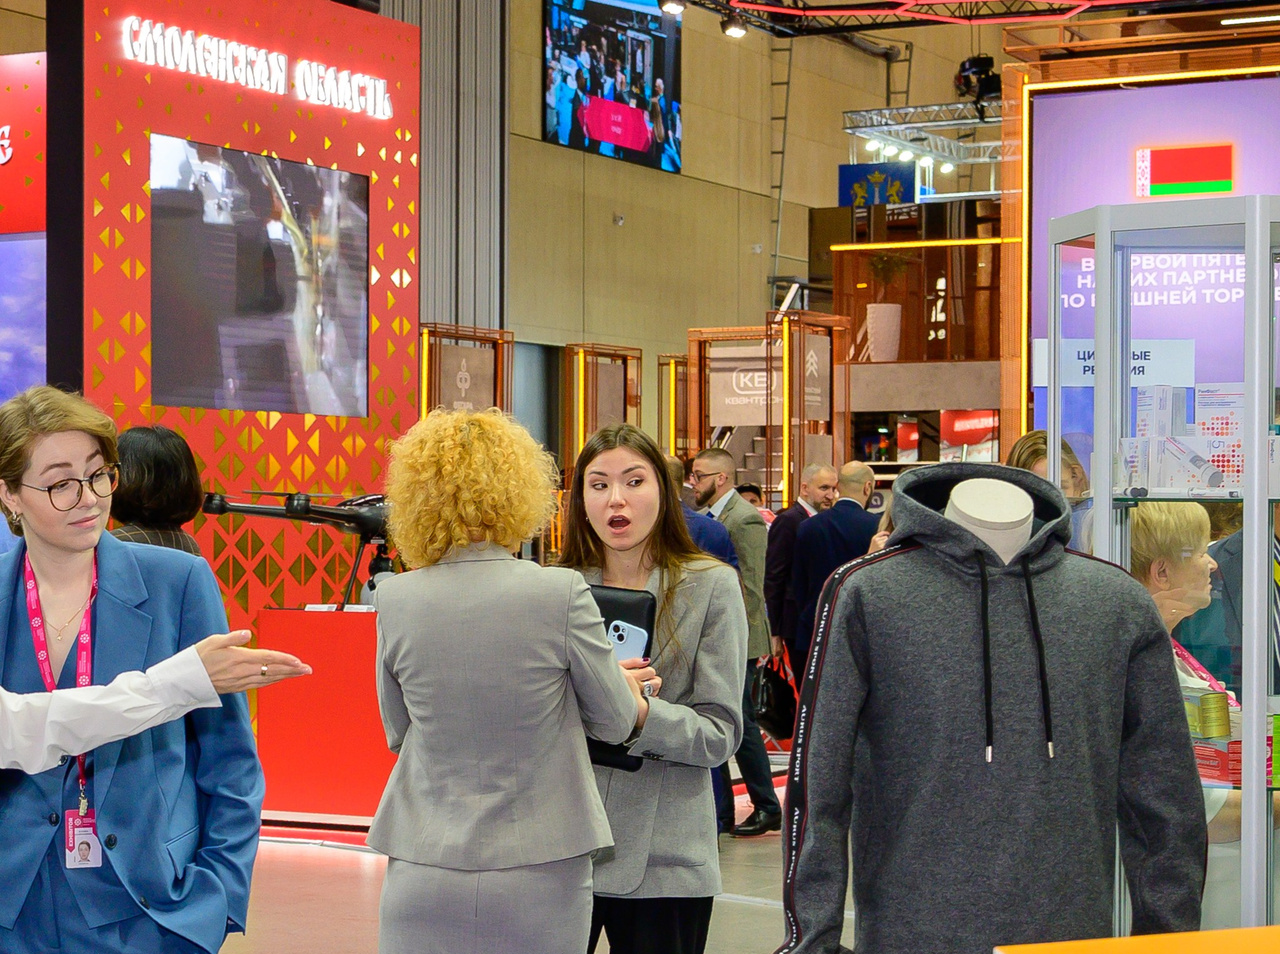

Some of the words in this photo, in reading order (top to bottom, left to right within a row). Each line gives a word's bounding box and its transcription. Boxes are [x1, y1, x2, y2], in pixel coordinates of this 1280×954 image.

[122, 16, 288, 95] СМОЛЕНСКАЯ
[297, 60, 393, 120] ОБЛАСТЬ
[817, 603, 829, 643] AURUS
[808, 645, 819, 680] SPORT
[797, 704, 807, 744] AURUS
[793, 747, 802, 783] SPORT
